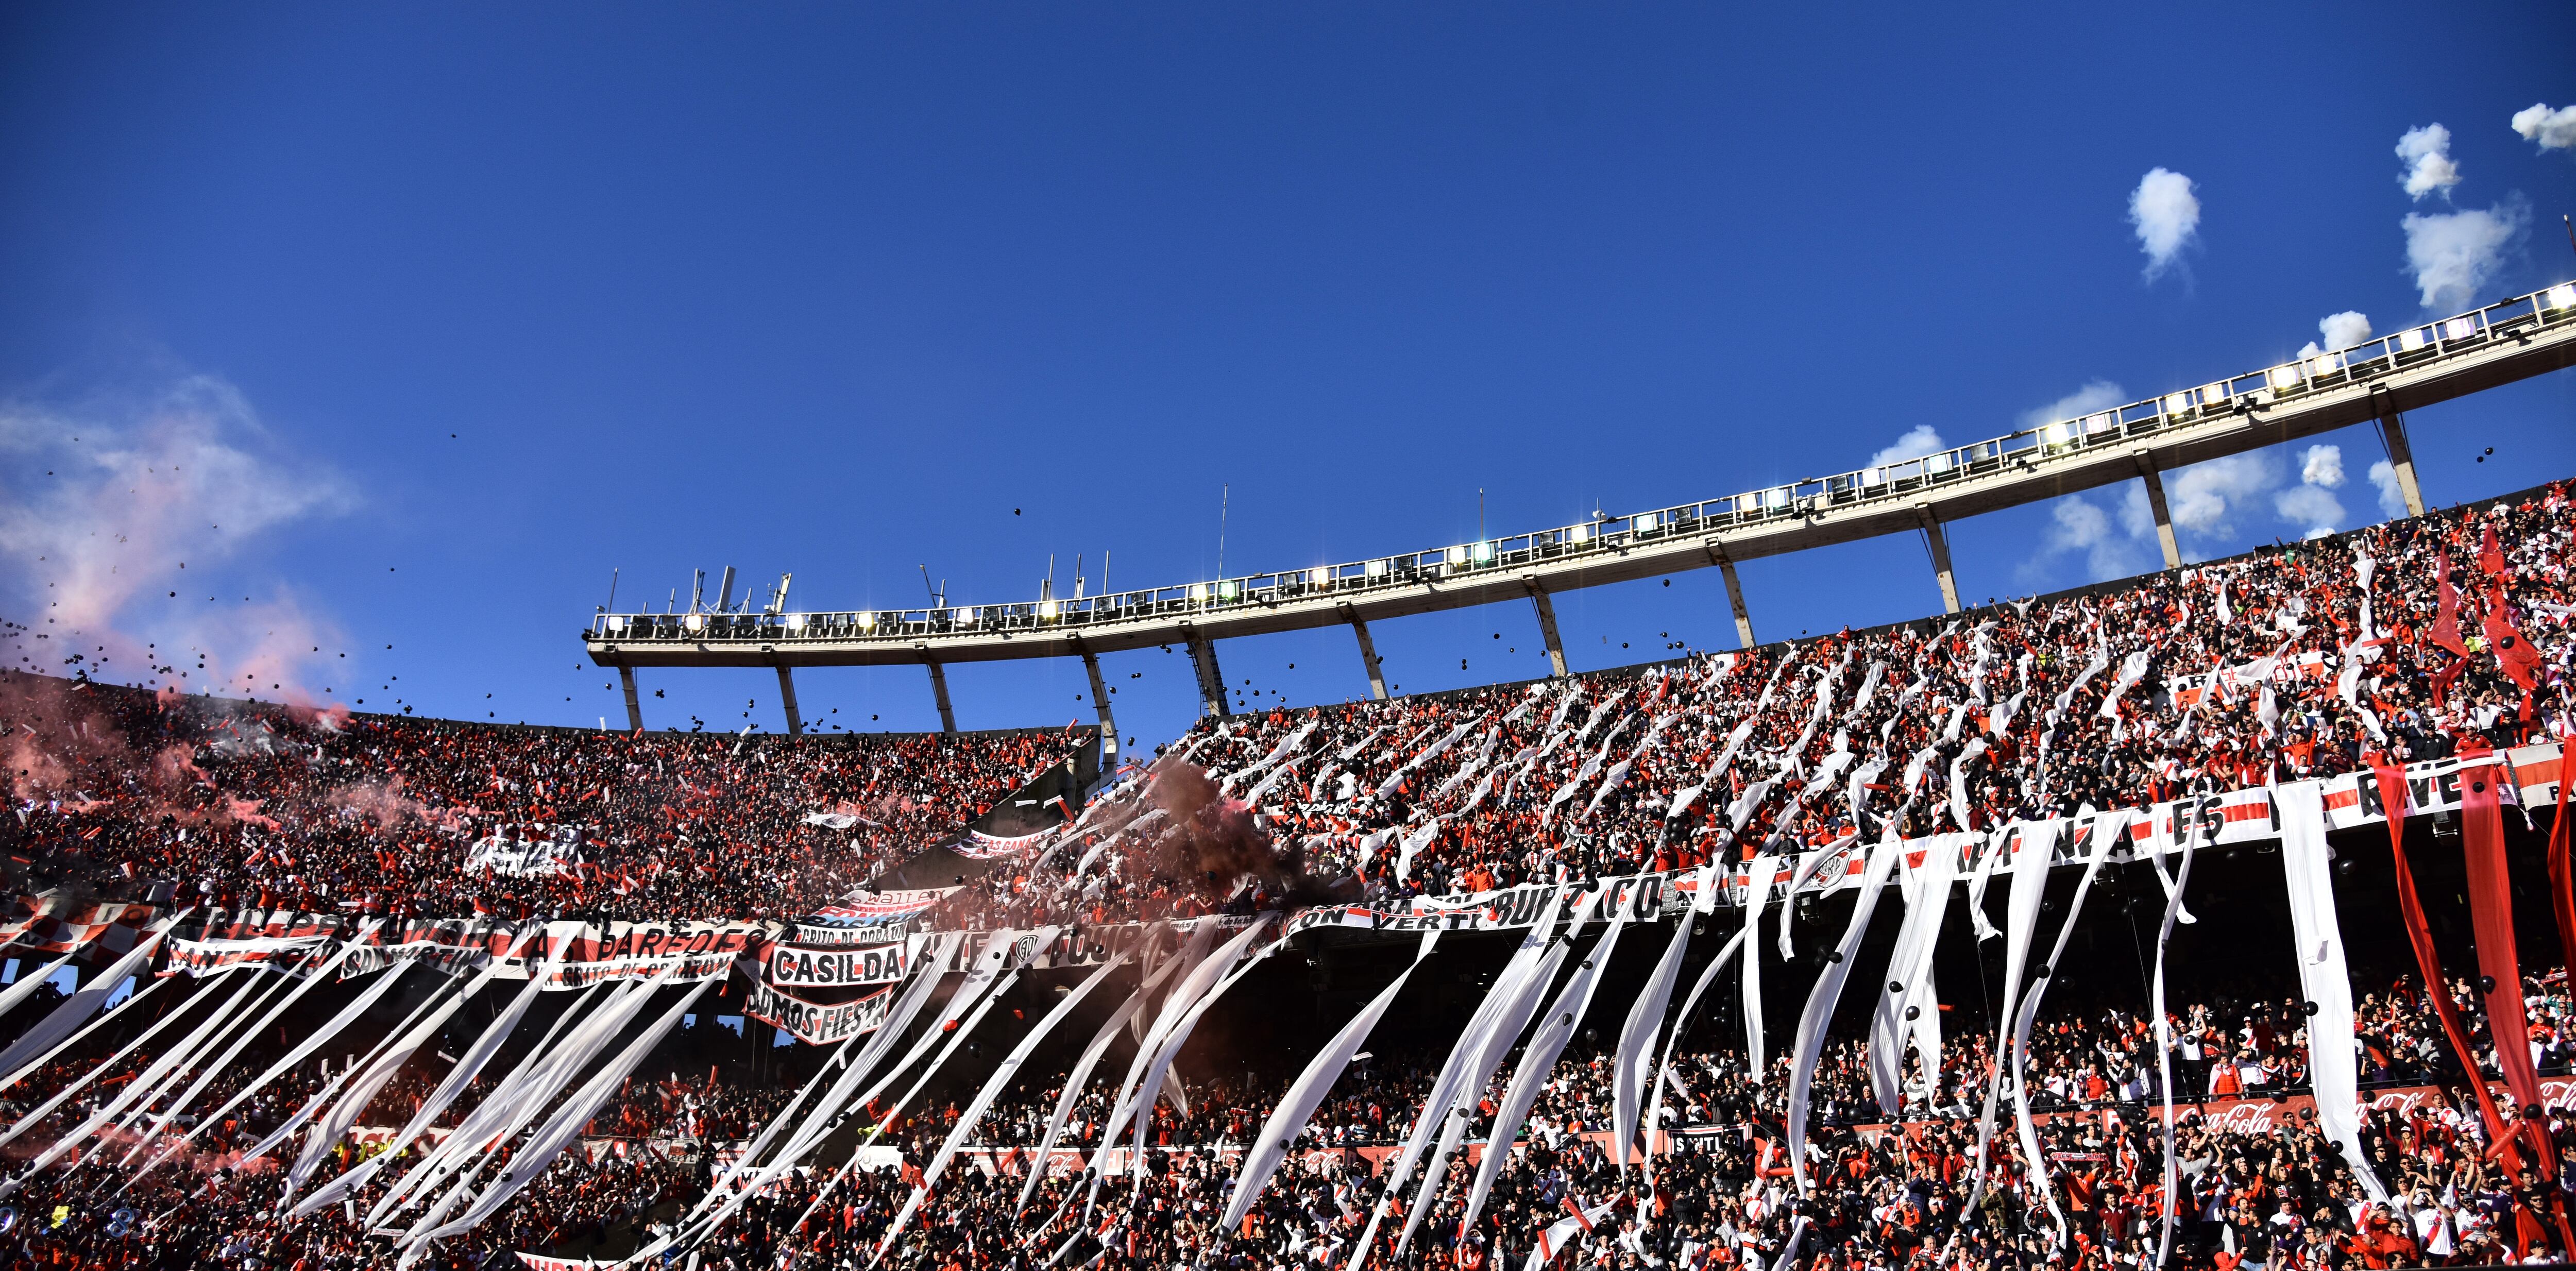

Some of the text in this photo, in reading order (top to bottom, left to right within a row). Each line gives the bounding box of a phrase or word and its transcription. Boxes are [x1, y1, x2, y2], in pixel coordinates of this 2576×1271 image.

[2172, 797, 2225, 846] ES
[1496, 876, 1663, 926] BURZCO
[801, 928, 835, 944] GRITO
[841, 931, 855, 943] DE
[1285, 909, 1347, 938] CON
[598, 928, 767, 962] PAREDES
[563, 963, 612, 987] GRITO
[621, 962, 640, 977] DE
[775, 948, 902, 984] CASILDA
[747, 981, 887, 1041] SOMOS FIESTA
[615, 1143, 625, 1158] A
